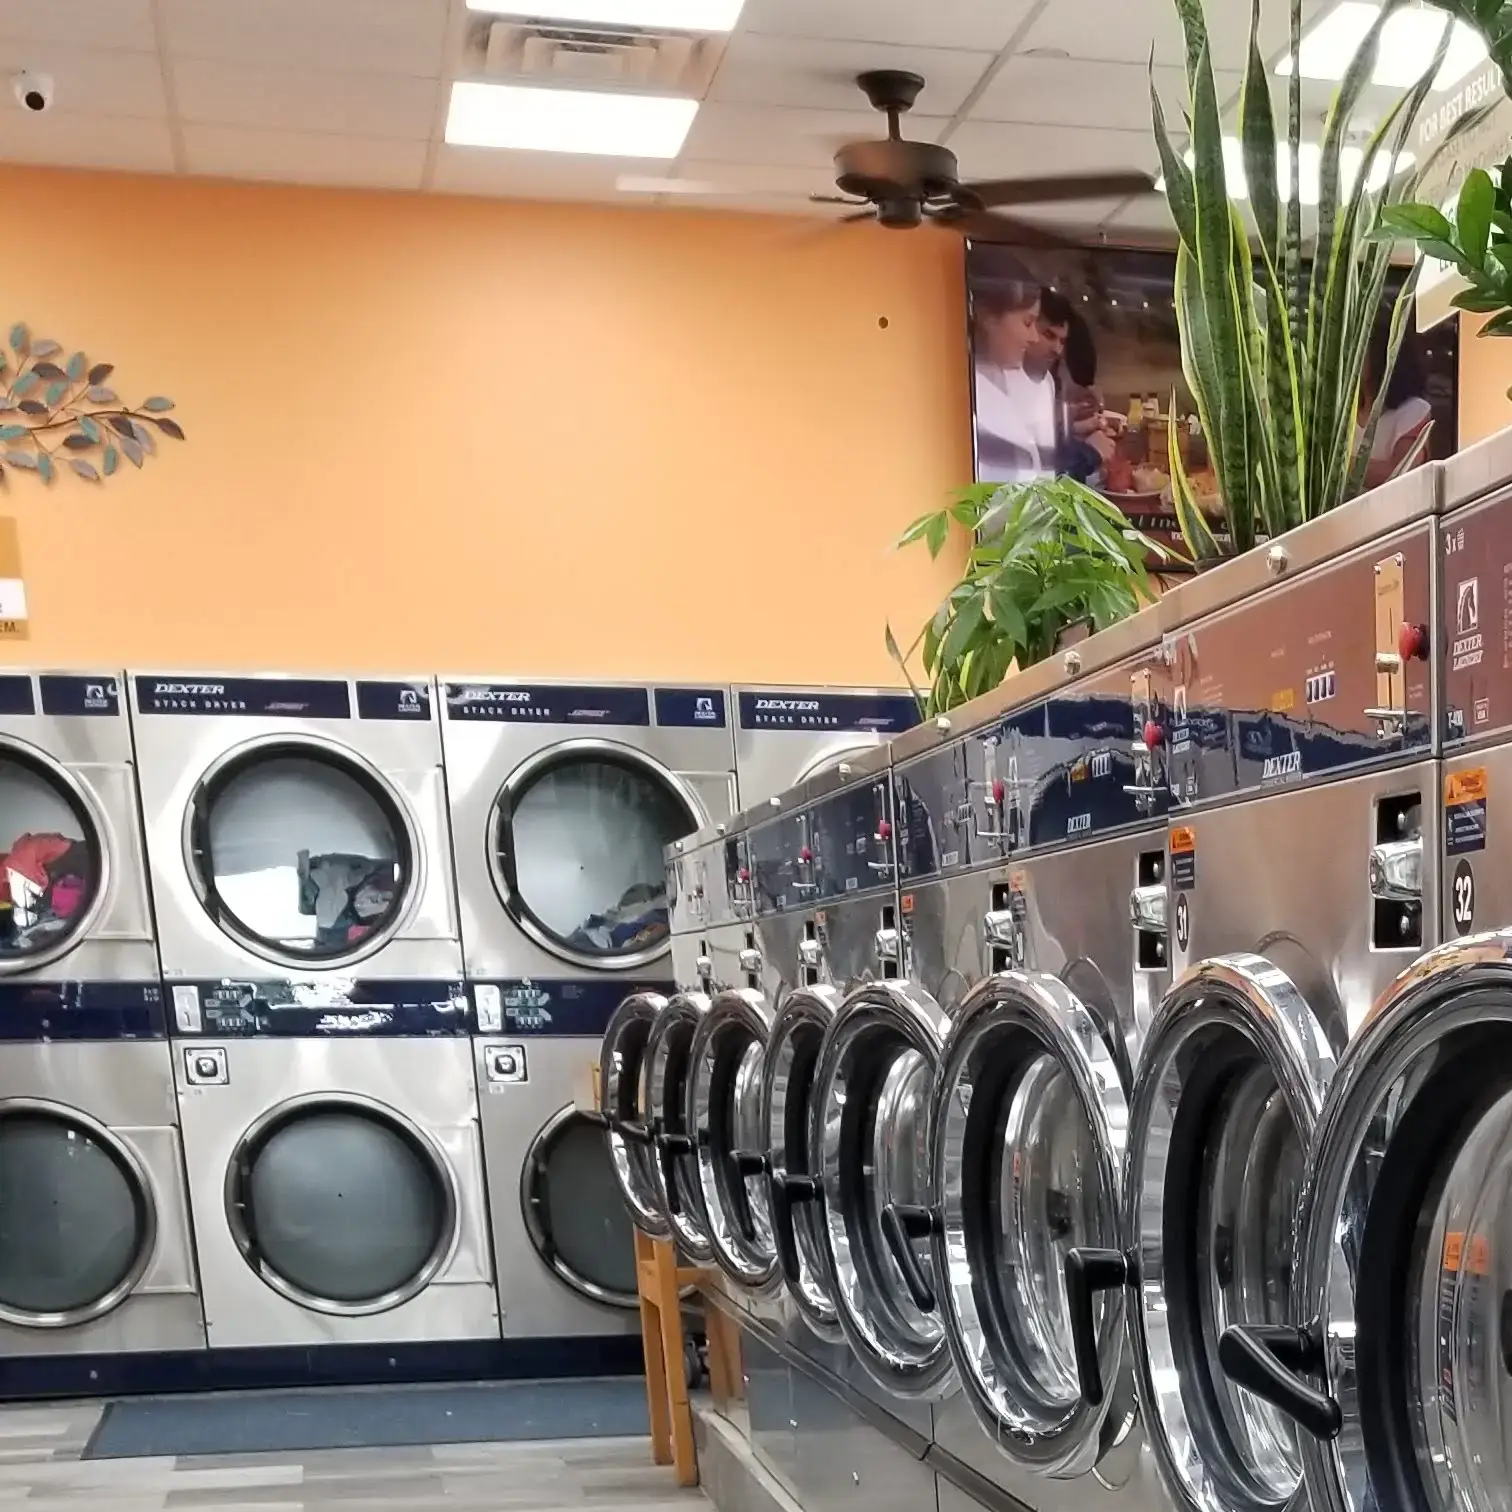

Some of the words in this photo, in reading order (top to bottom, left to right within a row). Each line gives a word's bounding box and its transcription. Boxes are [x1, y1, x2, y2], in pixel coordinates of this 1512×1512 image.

[154, 683, 225, 694] DEXTER
[463, 691, 531, 702] DEXTER
[154, 699, 197, 709] STACK
[205, 701, 246, 710] DRYER
[755, 700, 820, 710] DEXTER
[463, 706, 503, 715] STACK
[511, 707, 550, 716] DRYER
[755, 715, 794, 723] STACK
[801, 716, 839, 724] DRYER
[1262, 751, 1301, 779] DEXTER
[1455, 875, 1472, 923] 32
[1177, 904, 1188, 941] 31
